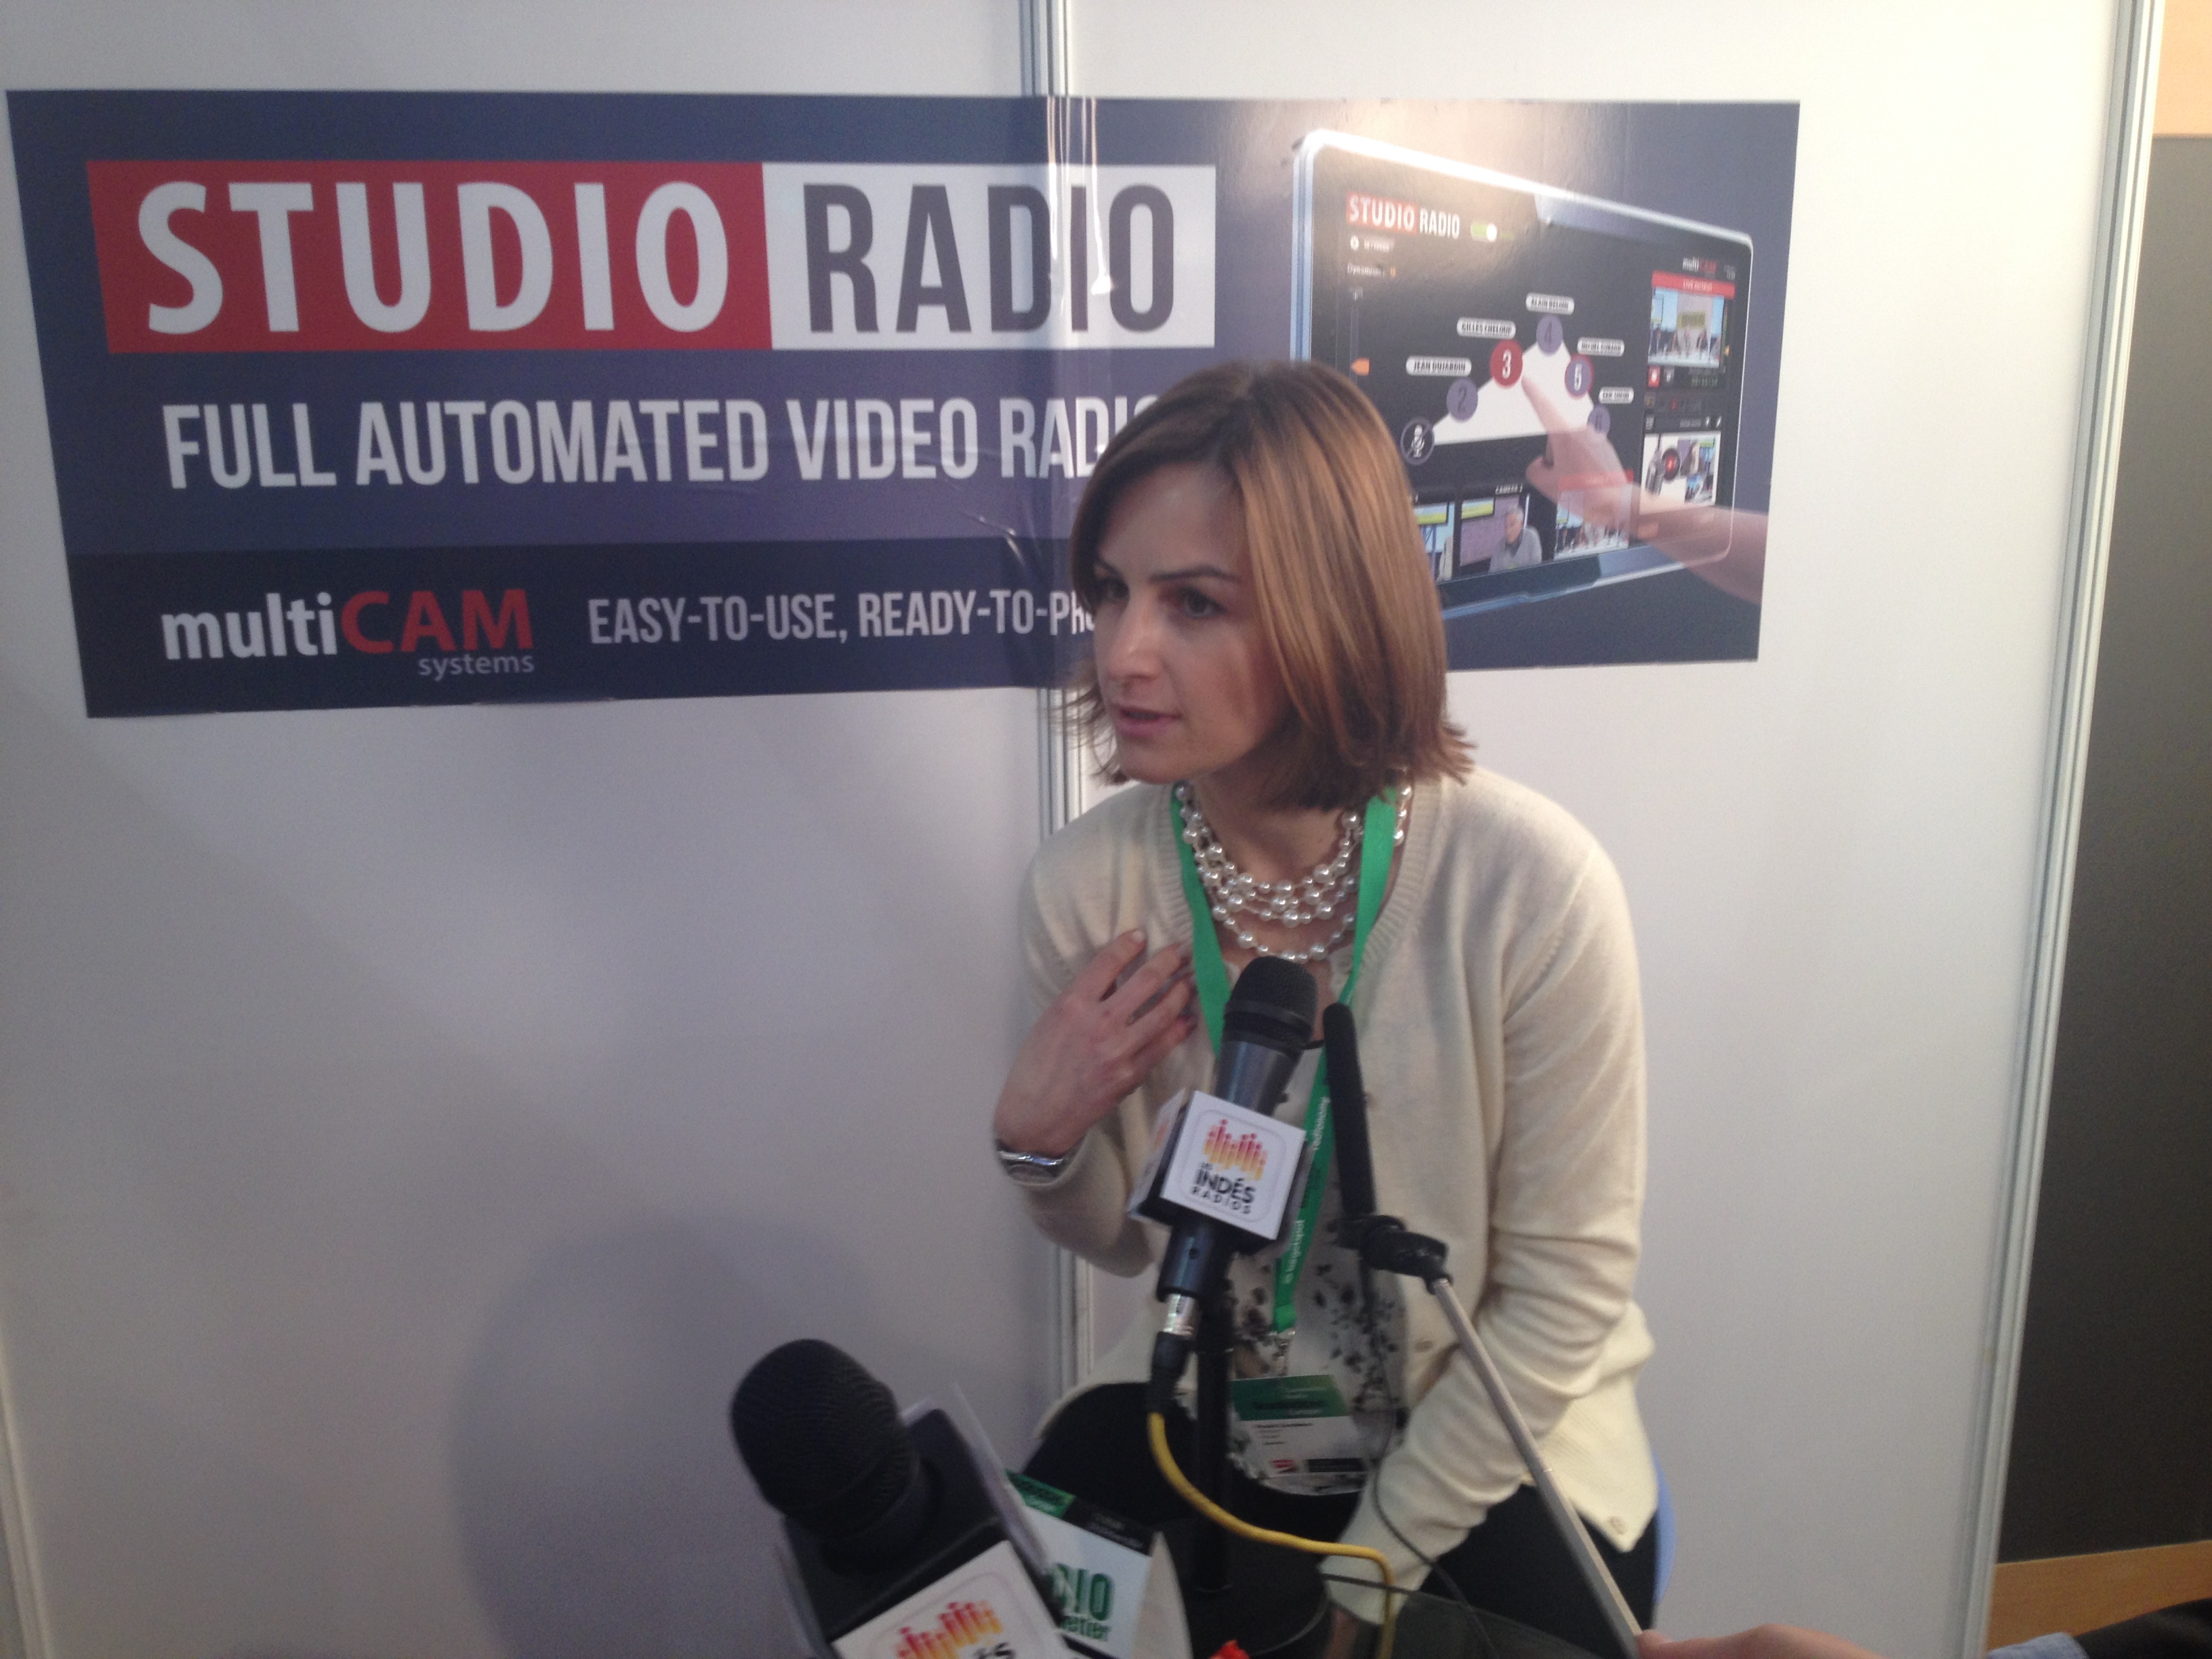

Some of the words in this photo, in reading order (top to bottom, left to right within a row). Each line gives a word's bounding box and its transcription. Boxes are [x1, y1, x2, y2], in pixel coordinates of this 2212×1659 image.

[1349, 194, 1415, 232] STUDIO
[1419, 207, 1460, 239] RADIO
[138, 180, 729, 334] STUDIO
[802, 183, 1174, 333] RADIO
[1543, 320, 1553, 346] 4
[1414, 361, 1431, 371] JEAN
[1502, 349, 1512, 380] 3
[1573, 363, 1583, 391] 5
[162, 403, 337, 490] FULL
[355, 399, 769, 487] AUTOMATED
[787, 397, 978, 480] VIDEO
[999, 394, 1160, 479] RAD
[161, 588, 534, 661] multiCAM
[588, 594, 848, 644] EASY-TO-USE,
[417, 654, 535, 682] systems
[1191, 1185, 1252, 1214] RADIOS
[1195, 1169, 1256, 1204] INDÉS
